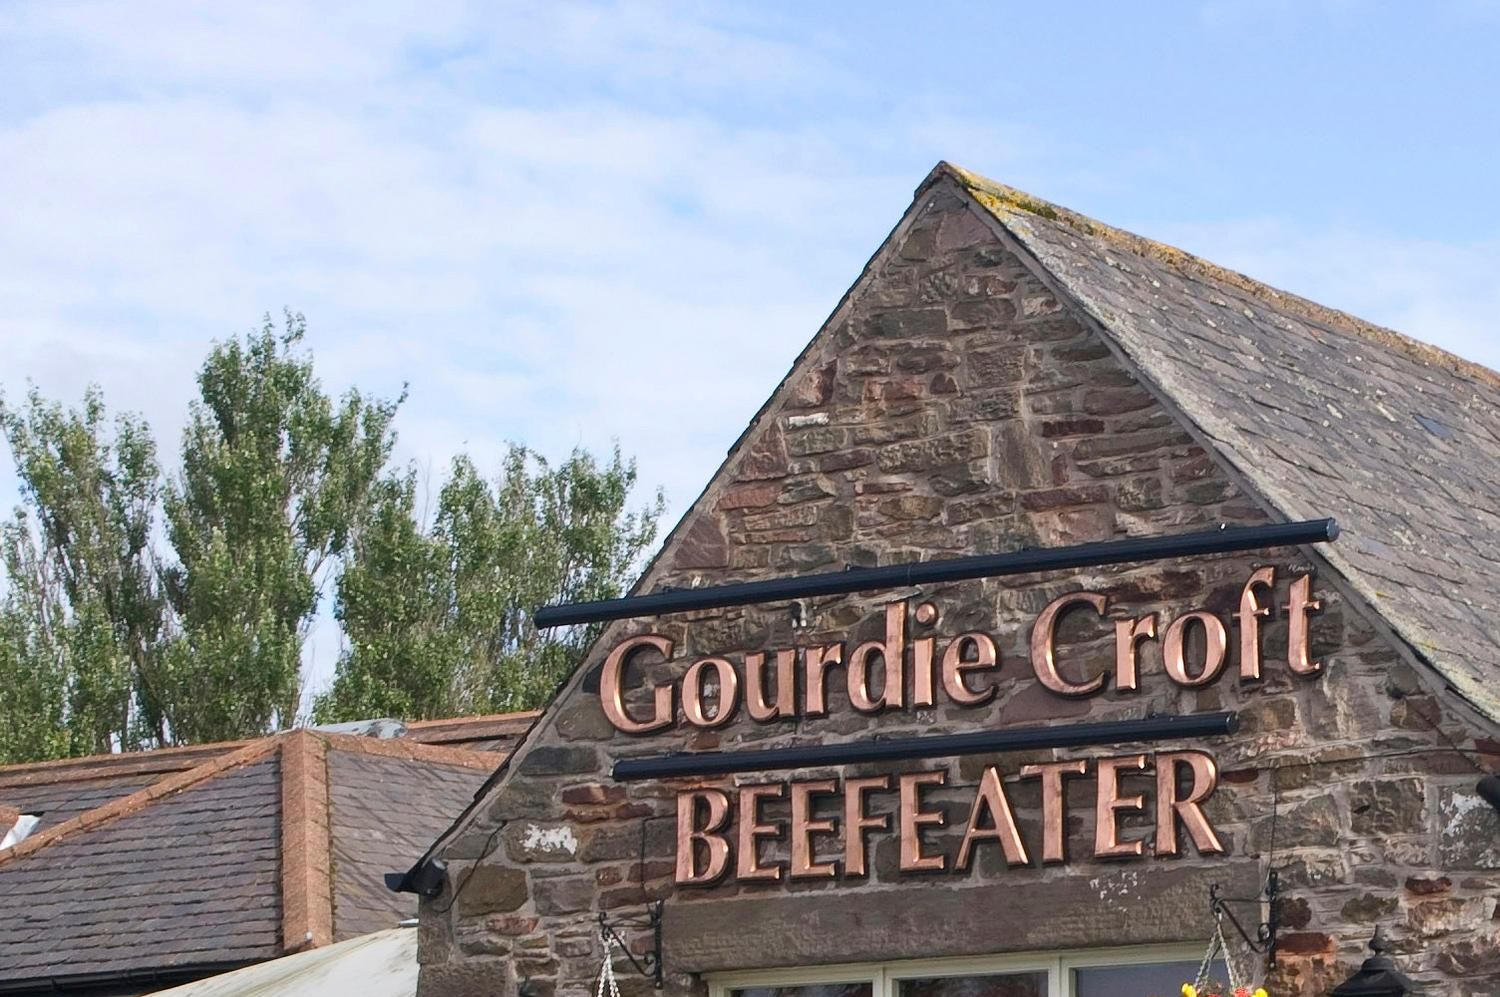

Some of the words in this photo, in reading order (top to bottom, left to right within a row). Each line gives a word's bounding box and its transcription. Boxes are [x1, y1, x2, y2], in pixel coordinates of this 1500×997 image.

[600, 600, 998, 735] Gourdie
[1029, 566, 1322, 698] Croft
[674, 749, 1225, 887] BEEFEATER
